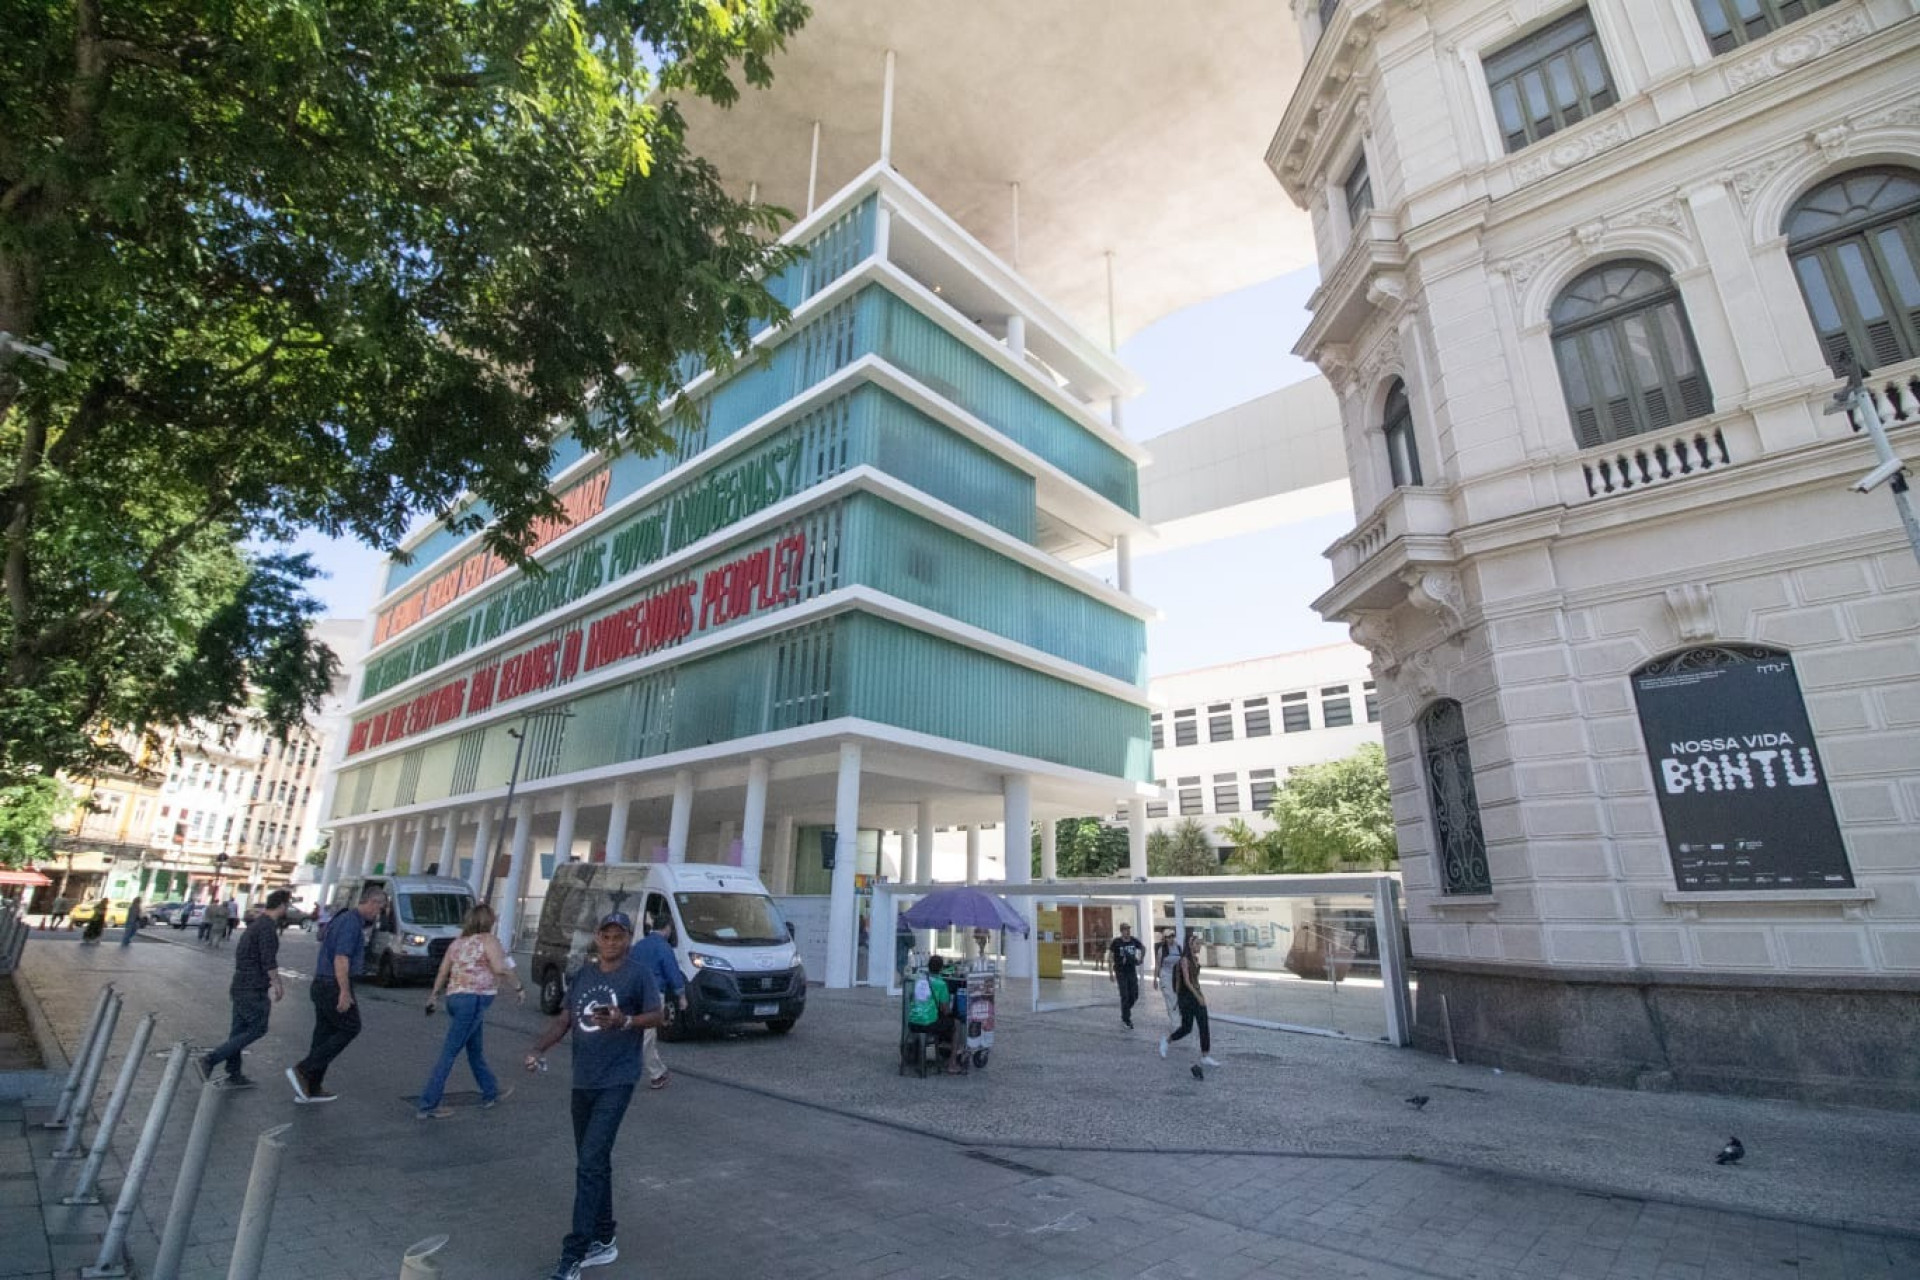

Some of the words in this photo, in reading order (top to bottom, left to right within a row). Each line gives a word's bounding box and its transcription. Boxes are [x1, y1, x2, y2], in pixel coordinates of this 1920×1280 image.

[571, 542, 607, 600] AOS
[608, 514, 665, 582] POVOS
[497, 639, 561, 703] BELONGS
[561, 627, 584, 680] TO
[583, 577, 697, 672] INDIGENOUS
[699, 531, 806, 630] PEOPLE?
[1661, 747, 1818, 794] BANTU
[1671, 735, 1740, 755] NOSSA
[1742, 732, 1794, 749] VIDA
